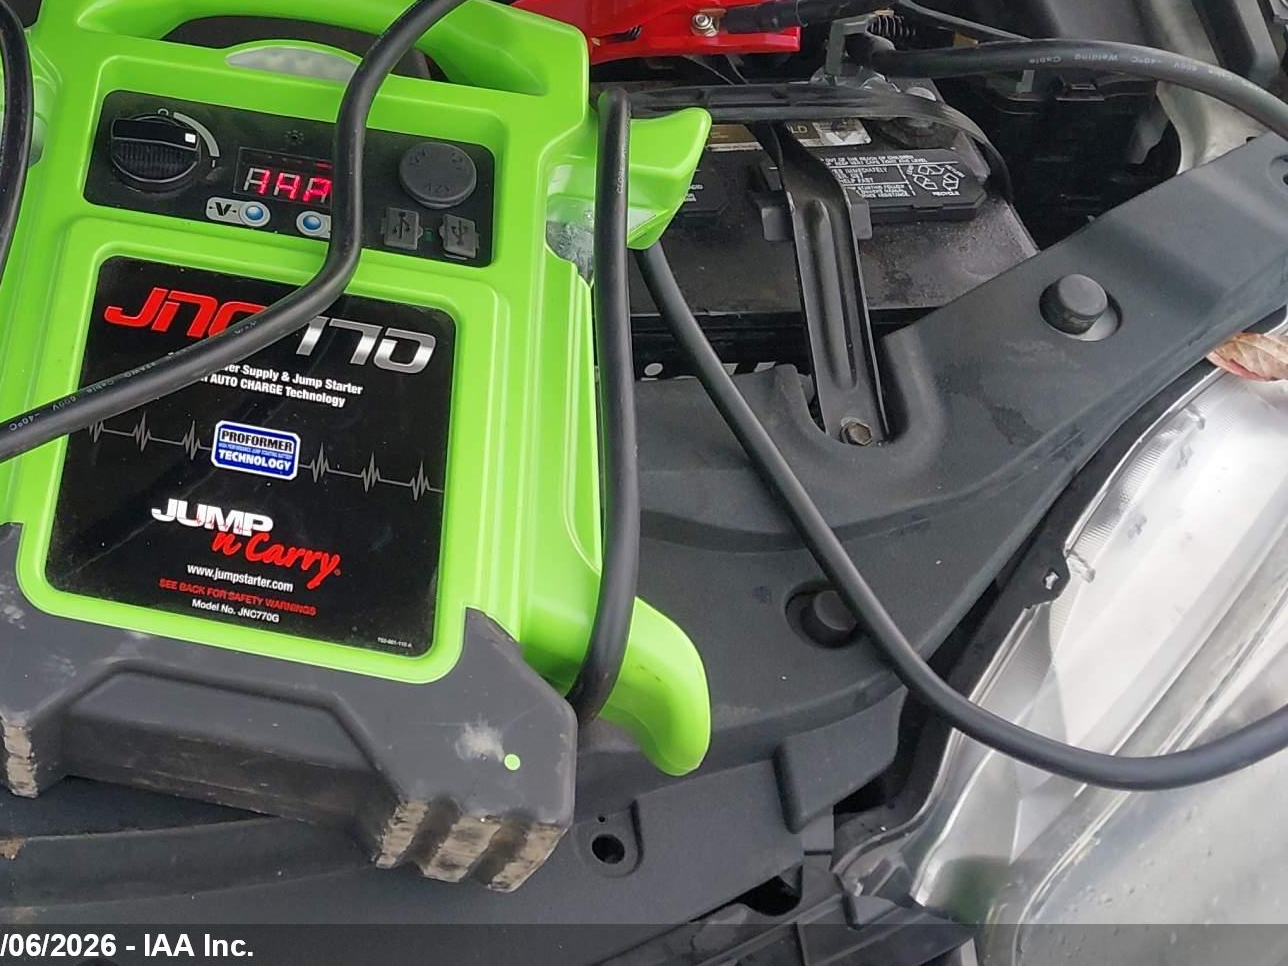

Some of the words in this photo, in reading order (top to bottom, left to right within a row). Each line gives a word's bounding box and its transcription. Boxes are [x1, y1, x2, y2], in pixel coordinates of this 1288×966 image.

[210, 373, 239, 388] AUTO
[240, 378, 283, 396] CHARGE
[285, 386, 346, 408] Technology
[242, 365, 279, 382] Supply
[281, 371, 291, 382] &
[292, 373, 323, 389] Jump
[324, 378, 364, 395] Starter
[221, 430, 293, 452] PROFORMER
[218, 449, 292, 471] TECHNOLOGY
[151, 498, 274, 536] JUMP
[186, 564, 294, 593] www.jumpstarter.com
[159, 578, 179, 590] SEE
[179, 583, 206, 596] BACK
[207, 588, 228, 600] FOR
[228, 590, 265, 606] SAFETY
[265, 597, 317, 616] WARNINGS
[192, 599, 220, 612] Model
[221, 602, 236, 615] No.
